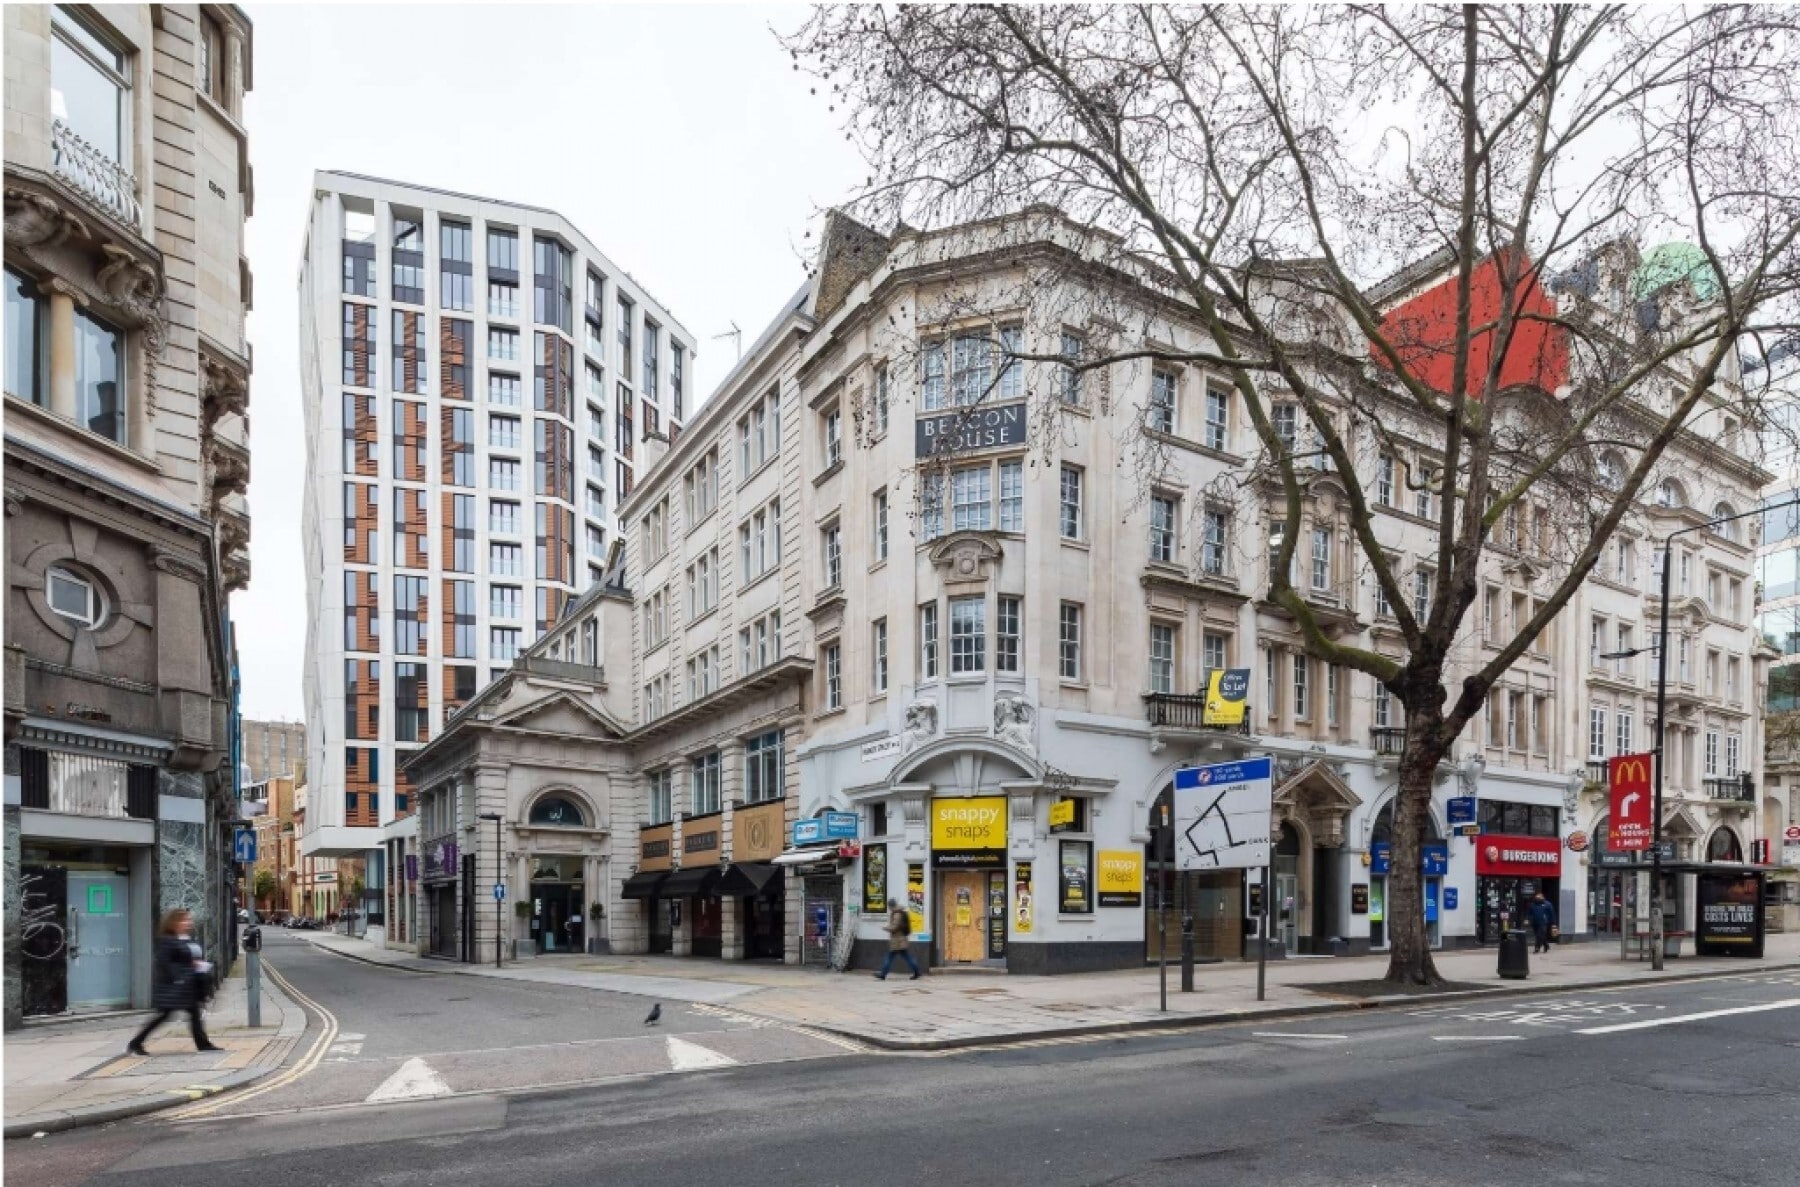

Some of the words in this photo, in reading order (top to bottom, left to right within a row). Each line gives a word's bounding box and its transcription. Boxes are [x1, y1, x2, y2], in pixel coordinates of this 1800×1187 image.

[940, 808, 1000, 824] snappy
[946, 825, 991, 841] snaps
[1102, 859, 1137, 872] snappy
[1106, 871, 1133, 885] snaps
